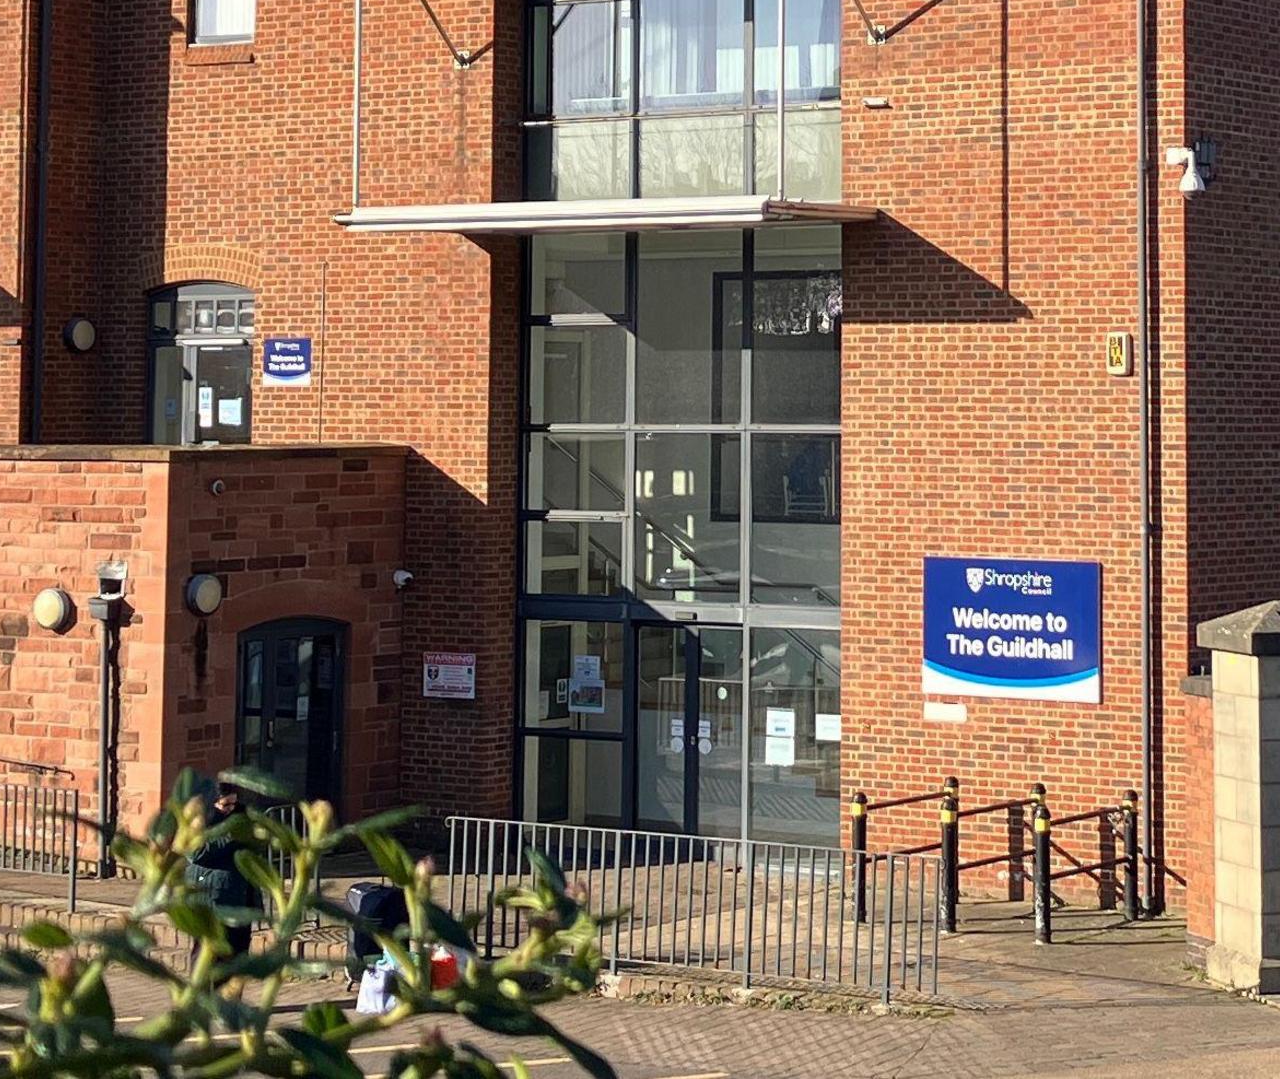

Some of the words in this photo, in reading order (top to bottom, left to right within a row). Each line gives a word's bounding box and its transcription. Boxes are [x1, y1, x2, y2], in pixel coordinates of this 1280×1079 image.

[985, 569, 1053, 591] Shropshire
[1022, 586, 1053, 596] Council
[951, 606, 1043, 632] Welcome
[1045, 611, 1068, 633] to
[945, 633, 984, 656] The
[987, 635, 1074, 661] Guildhall
[426, 654, 474, 665] WARNING
